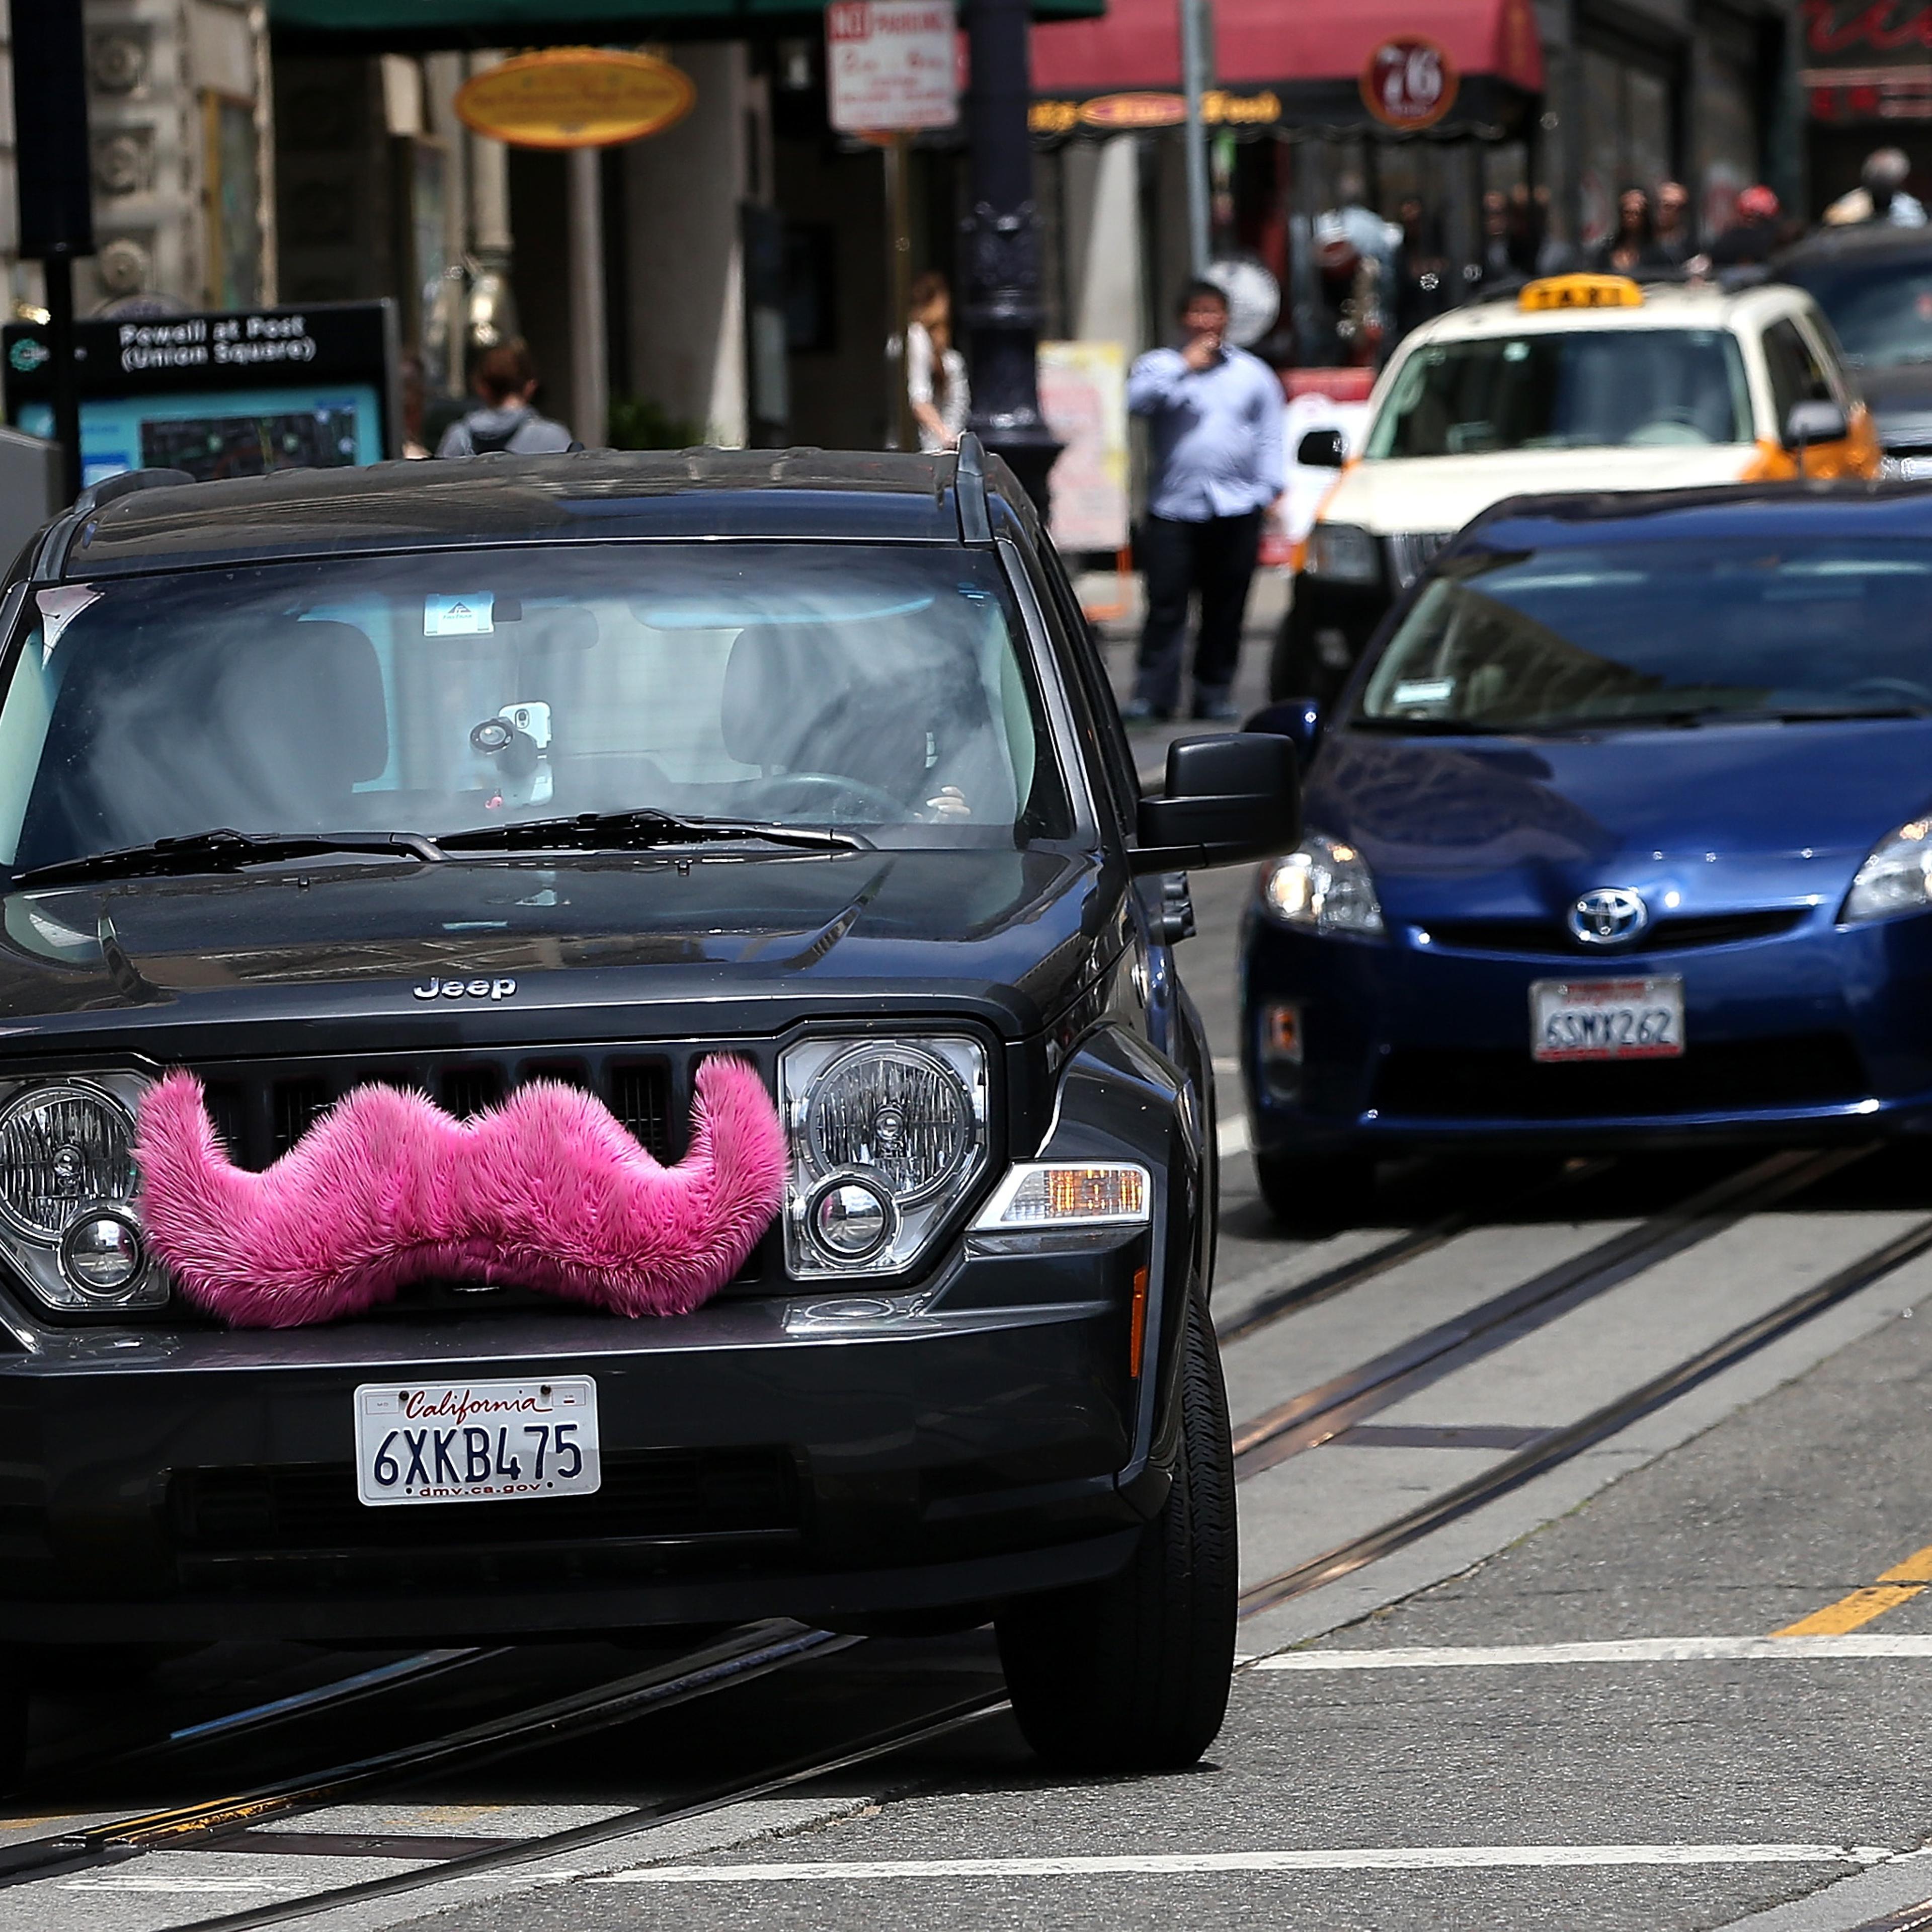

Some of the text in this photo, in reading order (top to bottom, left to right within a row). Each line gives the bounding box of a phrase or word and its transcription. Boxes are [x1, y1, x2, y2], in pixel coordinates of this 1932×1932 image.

[119, 314, 306, 346] Powell at Post
[121, 336, 316, 372] (Union Square)
[414, 977, 517, 1001] Jeep
[406, 1389, 553, 1424] California
[374, 1424, 583, 1486] 6XKB475
[419, 1483, 541, 1497] dmv.ca.gov
